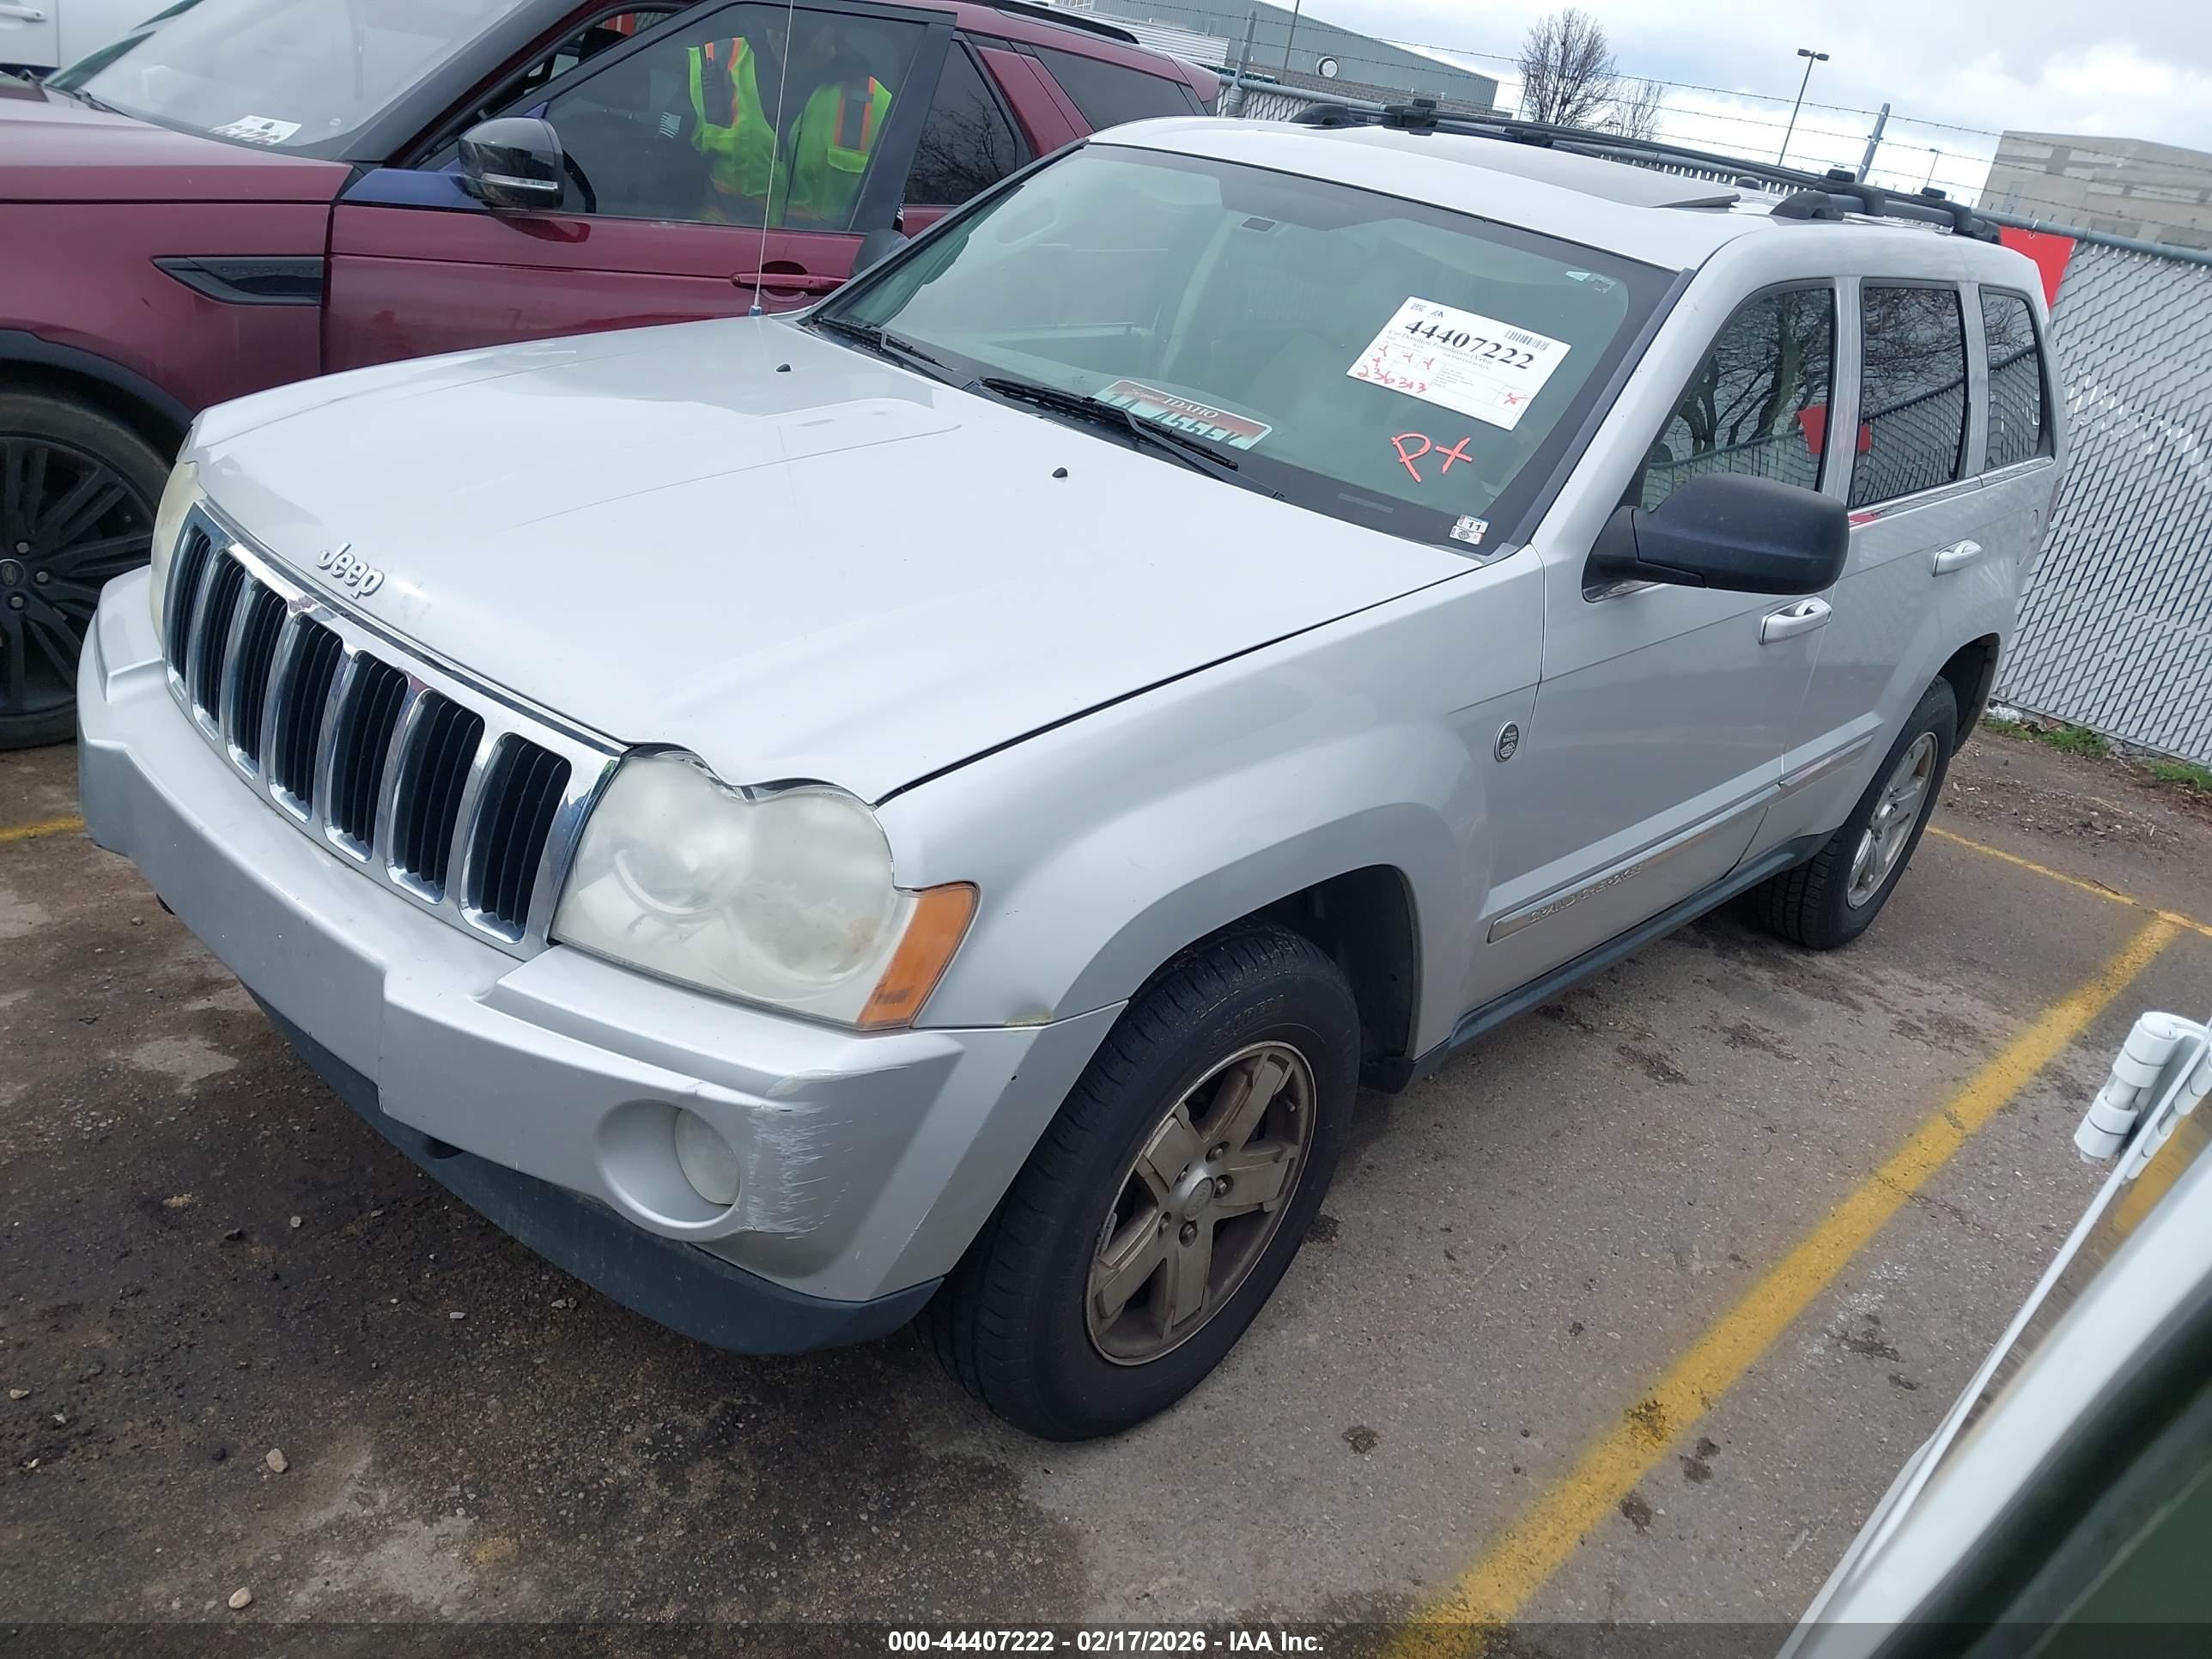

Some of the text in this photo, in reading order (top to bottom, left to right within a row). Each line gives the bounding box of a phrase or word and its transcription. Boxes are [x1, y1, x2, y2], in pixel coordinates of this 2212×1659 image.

[1404, 319, 1534, 370] 44407222
[1162, 398, 1219, 419] IDAHO
[1468, 521, 1481, 532] 11
[315, 542, 385, 599] Jeep
